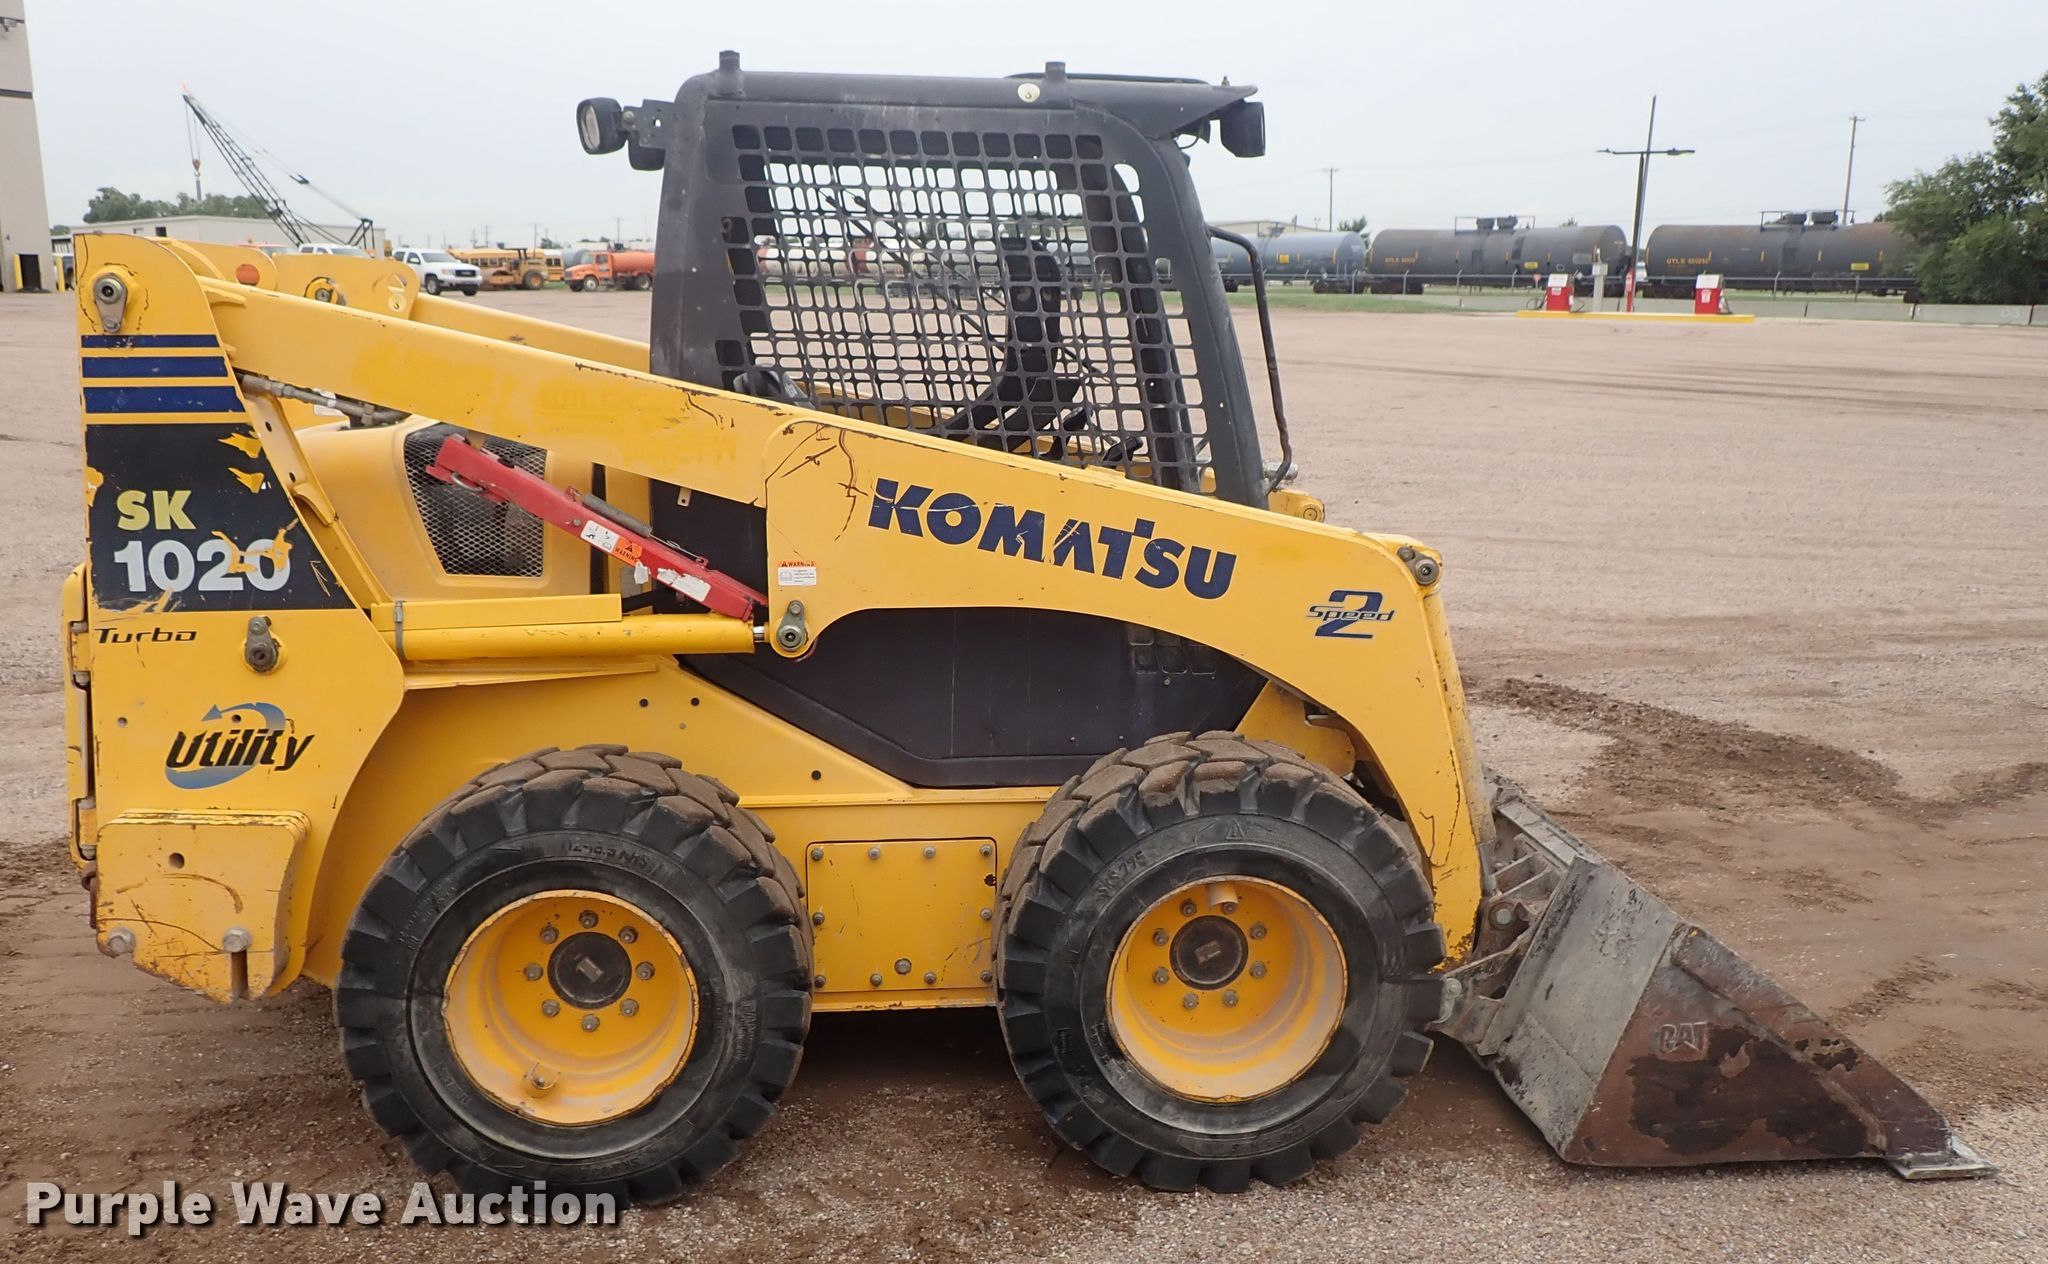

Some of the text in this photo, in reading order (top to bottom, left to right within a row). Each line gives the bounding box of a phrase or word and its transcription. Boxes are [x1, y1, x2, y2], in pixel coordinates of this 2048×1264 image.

[116, 490, 197, 530] SK
[868, 478, 1237, 599] KOMATSU
[114, 539, 291, 593] 1020
[1306, 605, 1394, 621] Speed
[94, 627, 198, 644] Turbo
[166, 728, 315, 771] Utility
